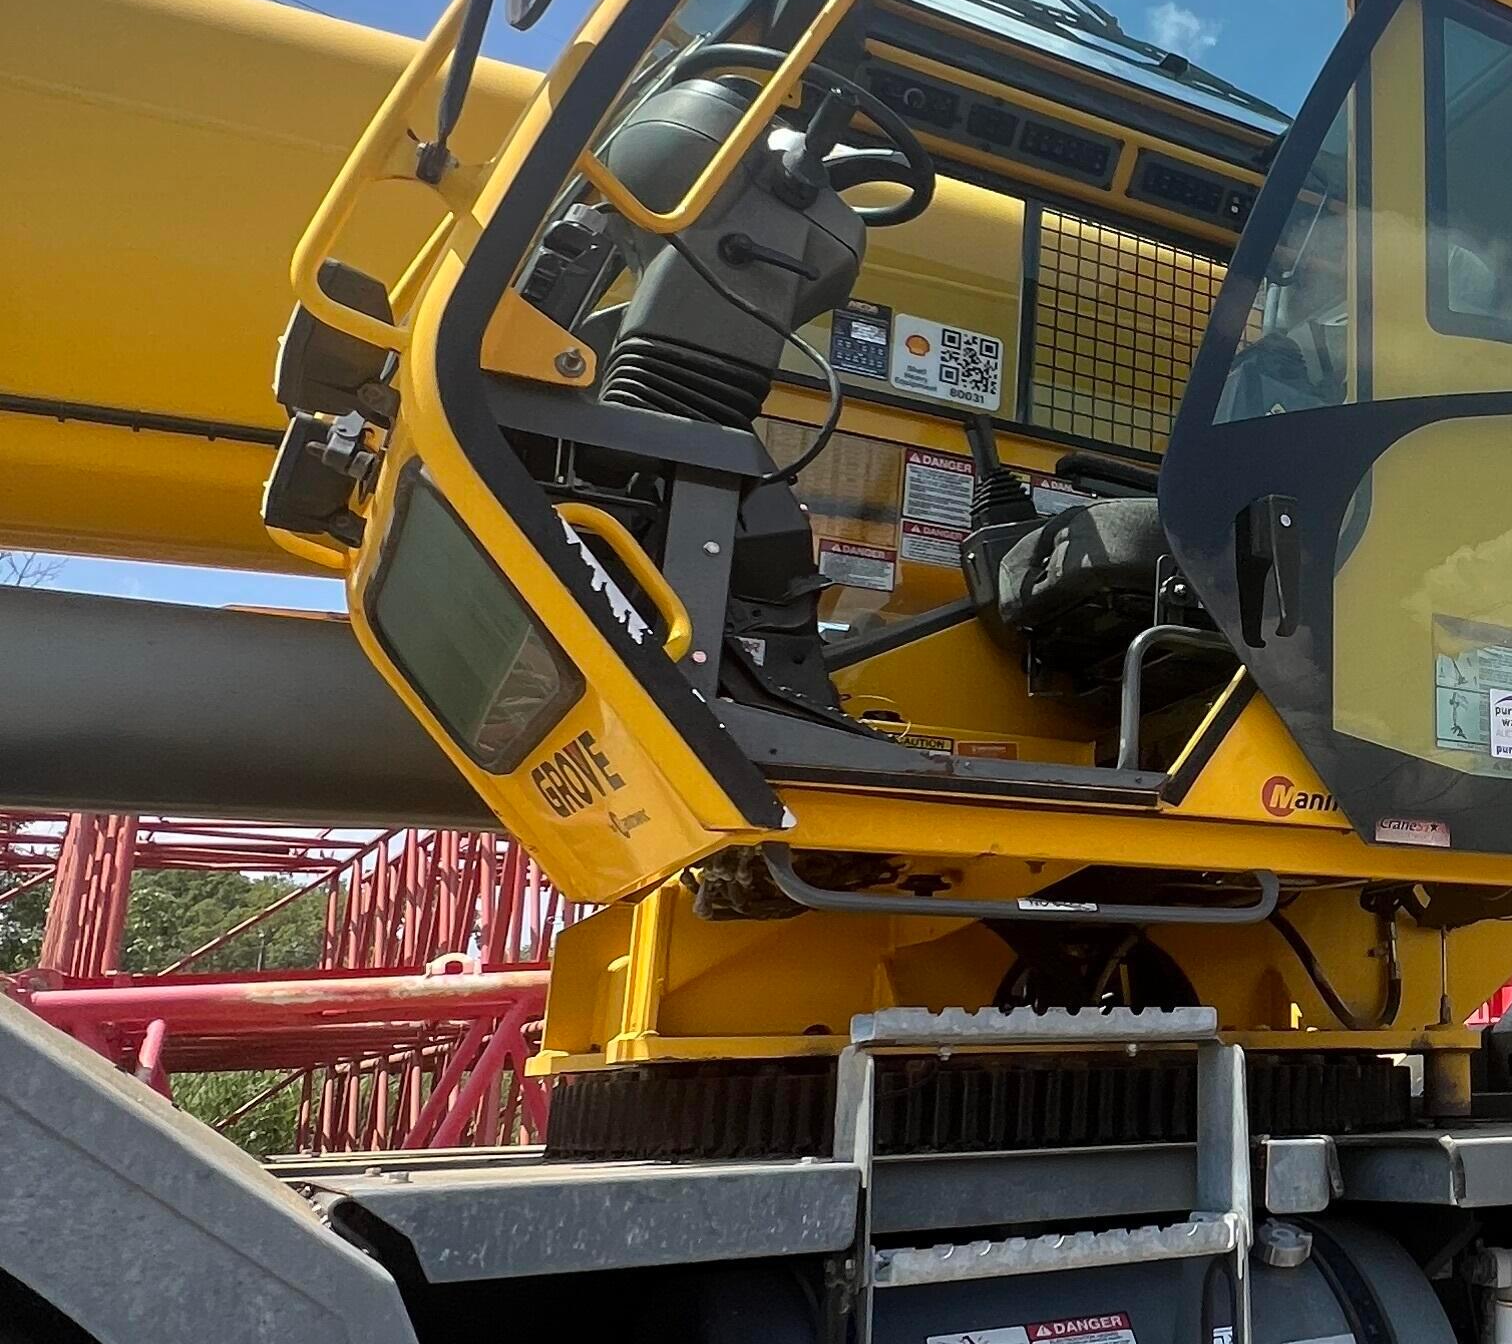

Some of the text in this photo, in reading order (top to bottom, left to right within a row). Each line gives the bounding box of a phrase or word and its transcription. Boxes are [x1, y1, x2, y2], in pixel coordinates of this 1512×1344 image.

[922, 455, 972, 474] DANGER
[923, 527, 963, 540] DANGER
[842, 545, 886, 559] DANGER
[531, 730, 627, 818] GROVE
[1053, 1315, 1123, 1335] DANGER
